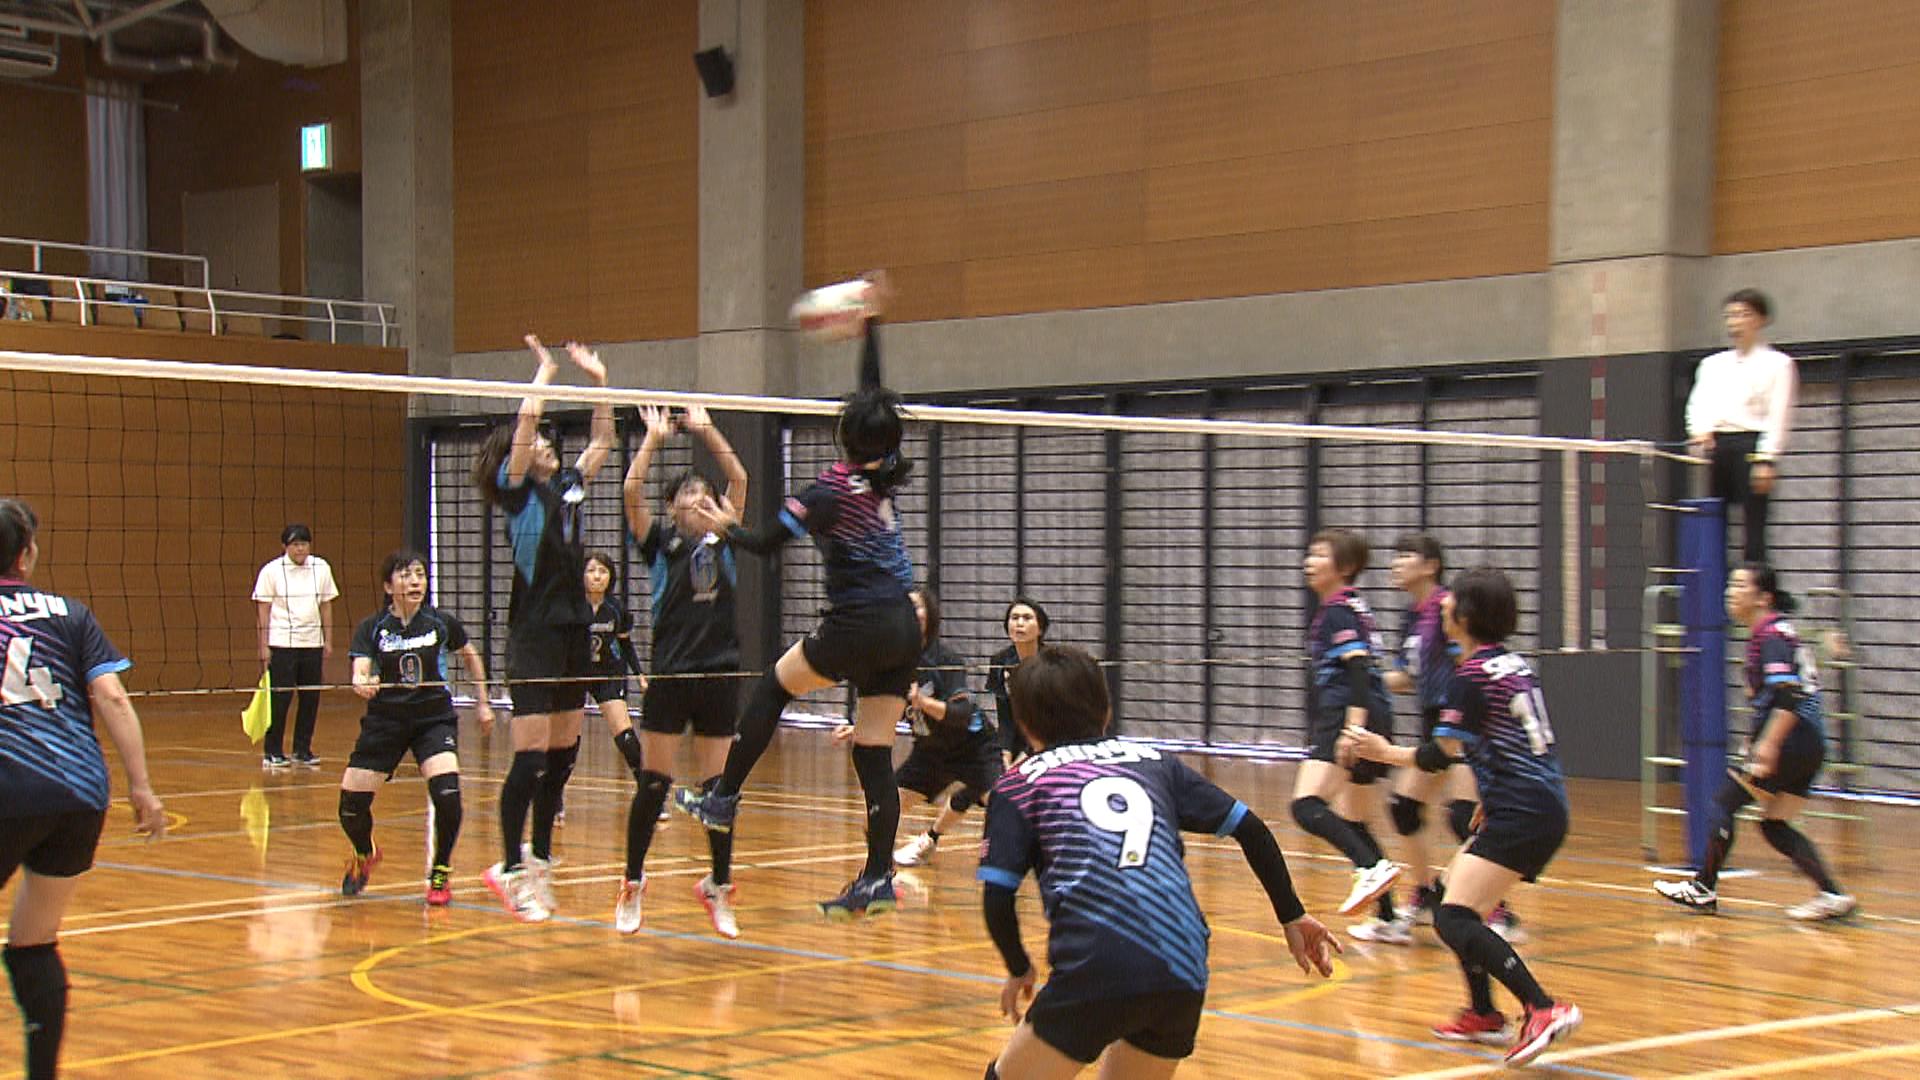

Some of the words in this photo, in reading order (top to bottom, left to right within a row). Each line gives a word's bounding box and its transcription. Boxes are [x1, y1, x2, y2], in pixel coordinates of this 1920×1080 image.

[0, 592, 69, 622] NYU
[1, 636, 63, 709] 4
[1080, 776, 1154, 870] 9
